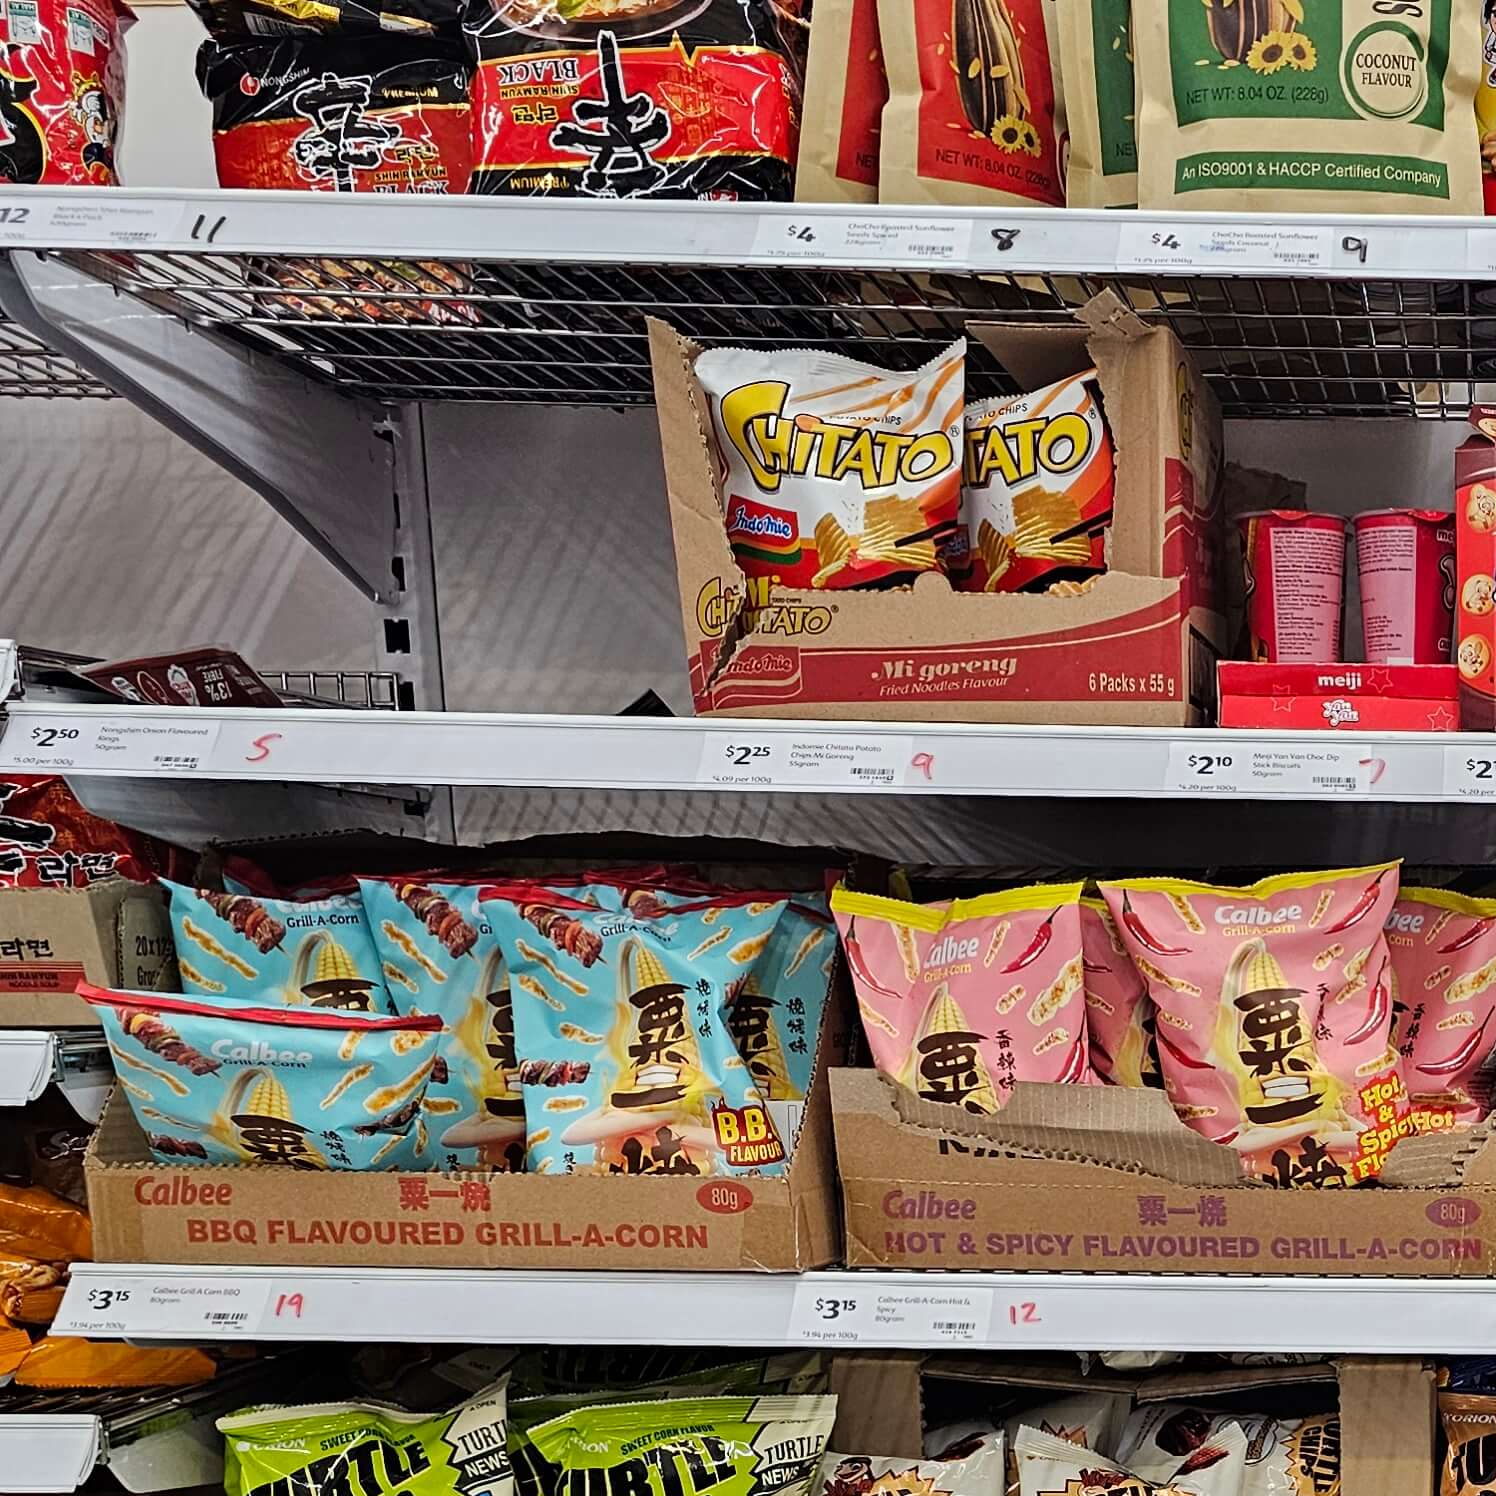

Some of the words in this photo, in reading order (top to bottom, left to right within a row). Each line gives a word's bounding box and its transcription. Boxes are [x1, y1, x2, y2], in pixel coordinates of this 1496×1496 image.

[1356, 52, 1416, 71] COCONUT
[1361, 70, 1412, 87] FLAVOUR
[1187, 88, 1211, 104] NET
[1238, 86, 1265, 101] 8.04
[1267, 86, 1288, 101] OZ.
[1291, 85, 1329, 104] (228g)
[1182, 164, 1197, 179] An
[1199, 162, 1254, 179] ISO9001
[1257, 164, 1267, 176] &
[1269, 162, 1321, 178] HACCP
[1324, 164, 1379, 181] Certified
[1383, 169, 1441, 188] Company
[787, 225, 816, 242] $4
[872, 659, 916, 680] Mi
[920, 657, 1018, 681] goreng
[880, 683, 907, 697] Fried
[910, 680, 959, 695] Noodles
[963, 677, 1008, 691] Flavour
[1089, 674, 1097, 692] 6
[1099, 674, 1135, 694] Packs
[1139, 678, 1147, 693] x
[1150, 674, 1164, 694] 55
[1167, 678, 1175, 697] g
[1317, 673, 1362, 689] meiji
[286, 912, 360, 929] Grill-A-Corn
[1213, 903, 1303, 924] Calbee
[134, 1175, 232, 1207] Calbee
[711, 1188, 738, 1209] 80g
[187, 1218, 258, 1244] BBQ
[267, 1220, 475, 1246] FLAVOURED
[482, 1223, 709, 1249] GRILL-A-CORN
[885, 1232, 950, 1255] HOT
[958, 1235, 976, 1255] &
[985, 1234, 1072, 1258] SPICY
[1083, 1236, 1260, 1259] FLAVOURED
[1271, 1237, 1481, 1261] GRILL-A-CORN
[275, 1293, 304, 1319] 19
